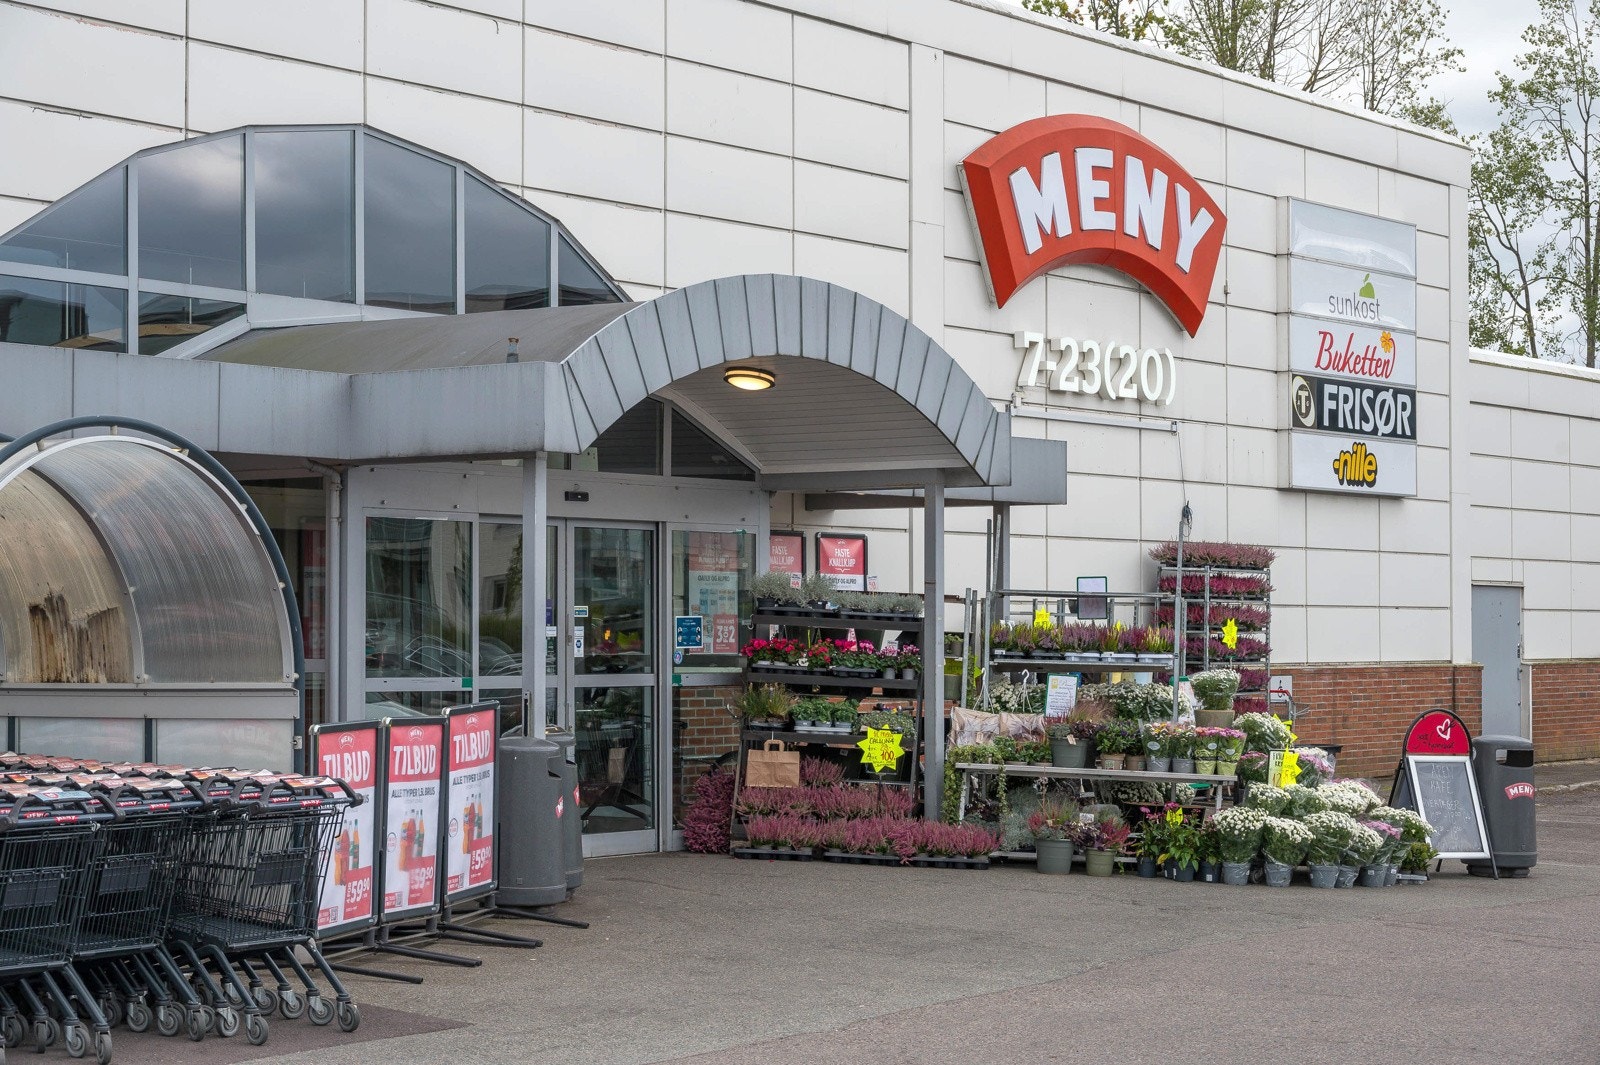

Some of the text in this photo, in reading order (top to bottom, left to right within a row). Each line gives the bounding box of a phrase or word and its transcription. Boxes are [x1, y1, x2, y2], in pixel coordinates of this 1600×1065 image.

[1009, 146, 1214, 274] MENY
[1328, 292, 1381, 321] sunkost
[1017, 330, 1176, 406] 7-23(20)
[1315, 330, 1396, 379] Buketten
[1323, 383, 1412, 436] FRISØR
[834, 548, 851, 557] FASTE
[393, 744, 437, 775] TILBUD
[453, 729, 491, 763] TILBUD
[322, 750, 371, 783] TILBUD
[1509, 785, 1533, 796] MENY
